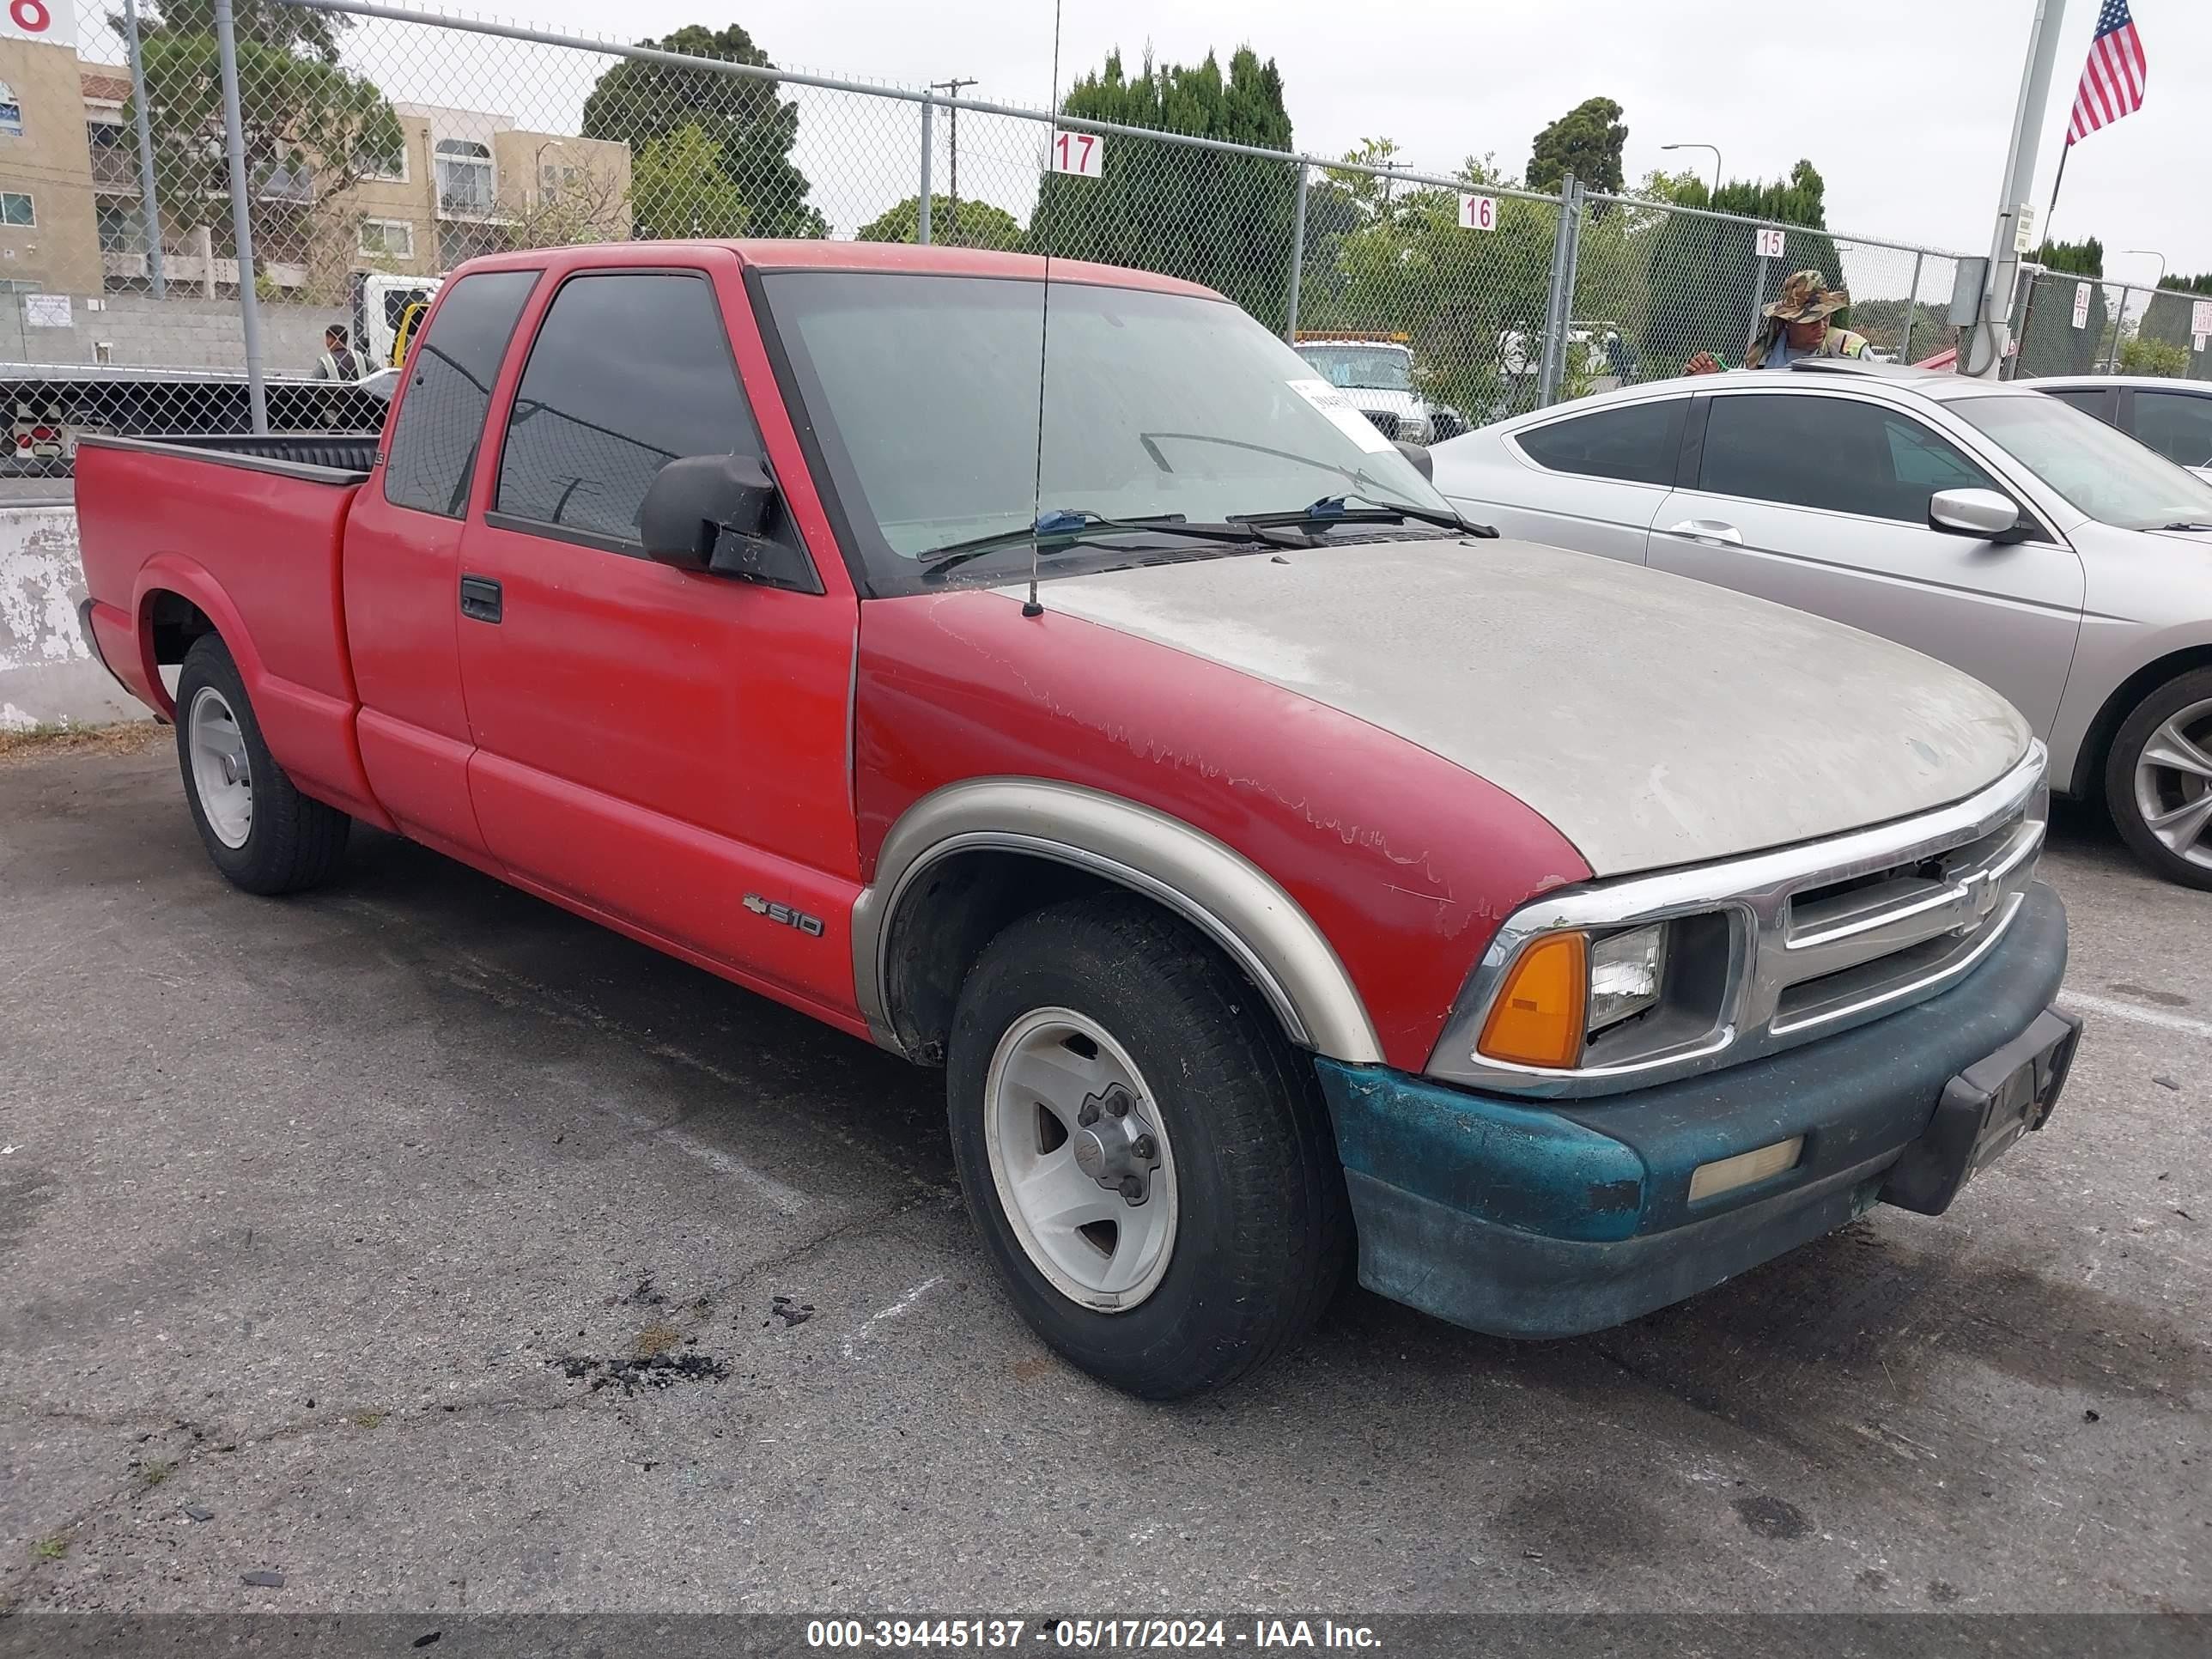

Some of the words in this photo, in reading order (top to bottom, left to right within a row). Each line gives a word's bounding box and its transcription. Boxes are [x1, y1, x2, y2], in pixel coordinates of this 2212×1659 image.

[1057, 133, 1095, 173] 17
[1468, 198, 1491, 228] 16
[1762, 232, 1780, 254] 15
[769, 902, 823, 937] S10
